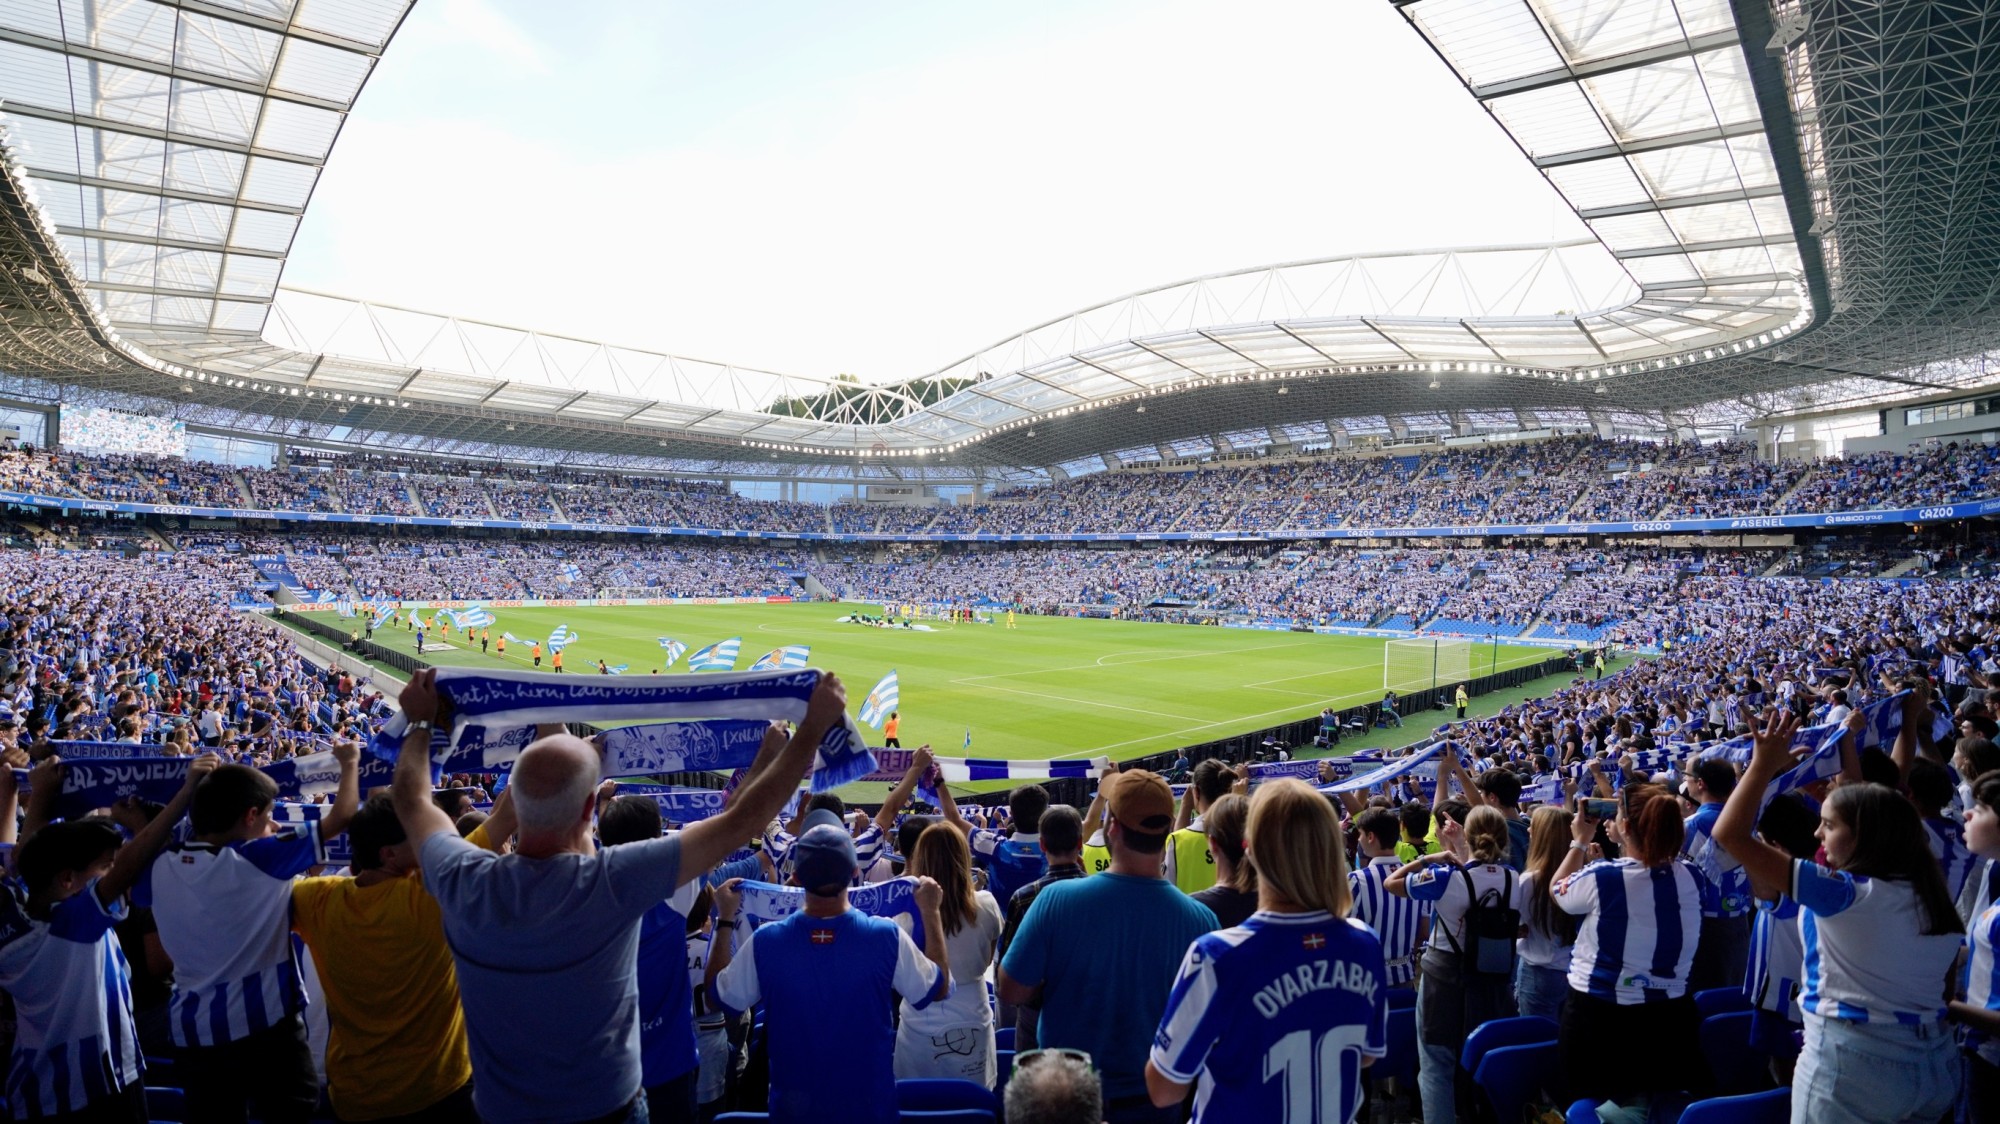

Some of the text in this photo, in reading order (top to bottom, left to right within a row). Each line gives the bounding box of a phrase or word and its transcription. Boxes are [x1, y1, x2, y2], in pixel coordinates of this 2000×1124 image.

[154, 506, 192, 515] CAZOO
[232, 510, 275, 519] kutxabank
[1919, 507, 1954, 519] CAZOO
[1632, 523, 1671, 531] CAZOO
[1740, 518, 1785, 527] ASENEL
[291, 603, 334, 611] CAZOO
[499, 727, 538, 747] REA
[102, 762, 190, 785] SOCIEDA
[1262, 1024, 1368, 1124] 10
